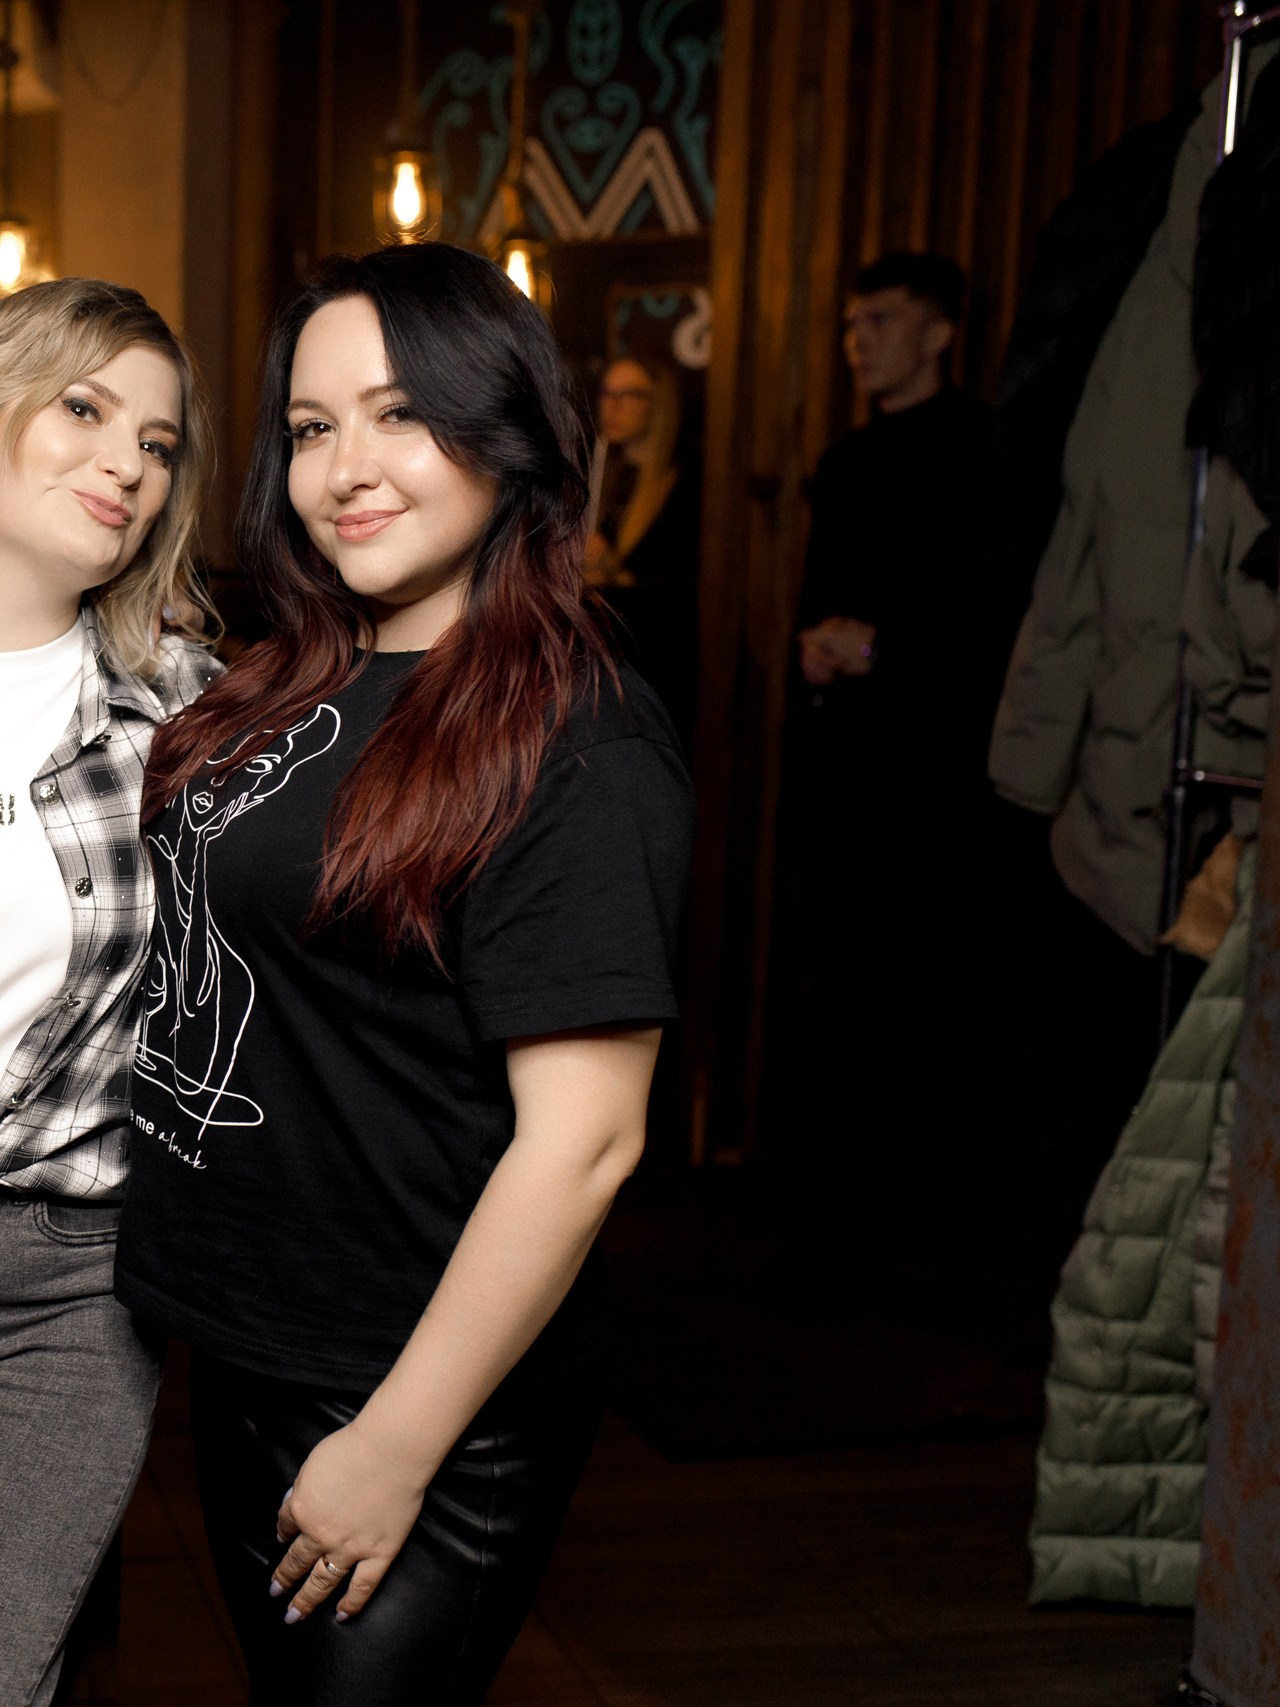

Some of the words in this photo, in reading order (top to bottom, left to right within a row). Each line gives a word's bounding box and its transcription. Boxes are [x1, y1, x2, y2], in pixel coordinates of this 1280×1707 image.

[135, 1114, 155, 1135] me
[158, 1131, 170, 1142] a
[168, 1132, 207, 1169] break
